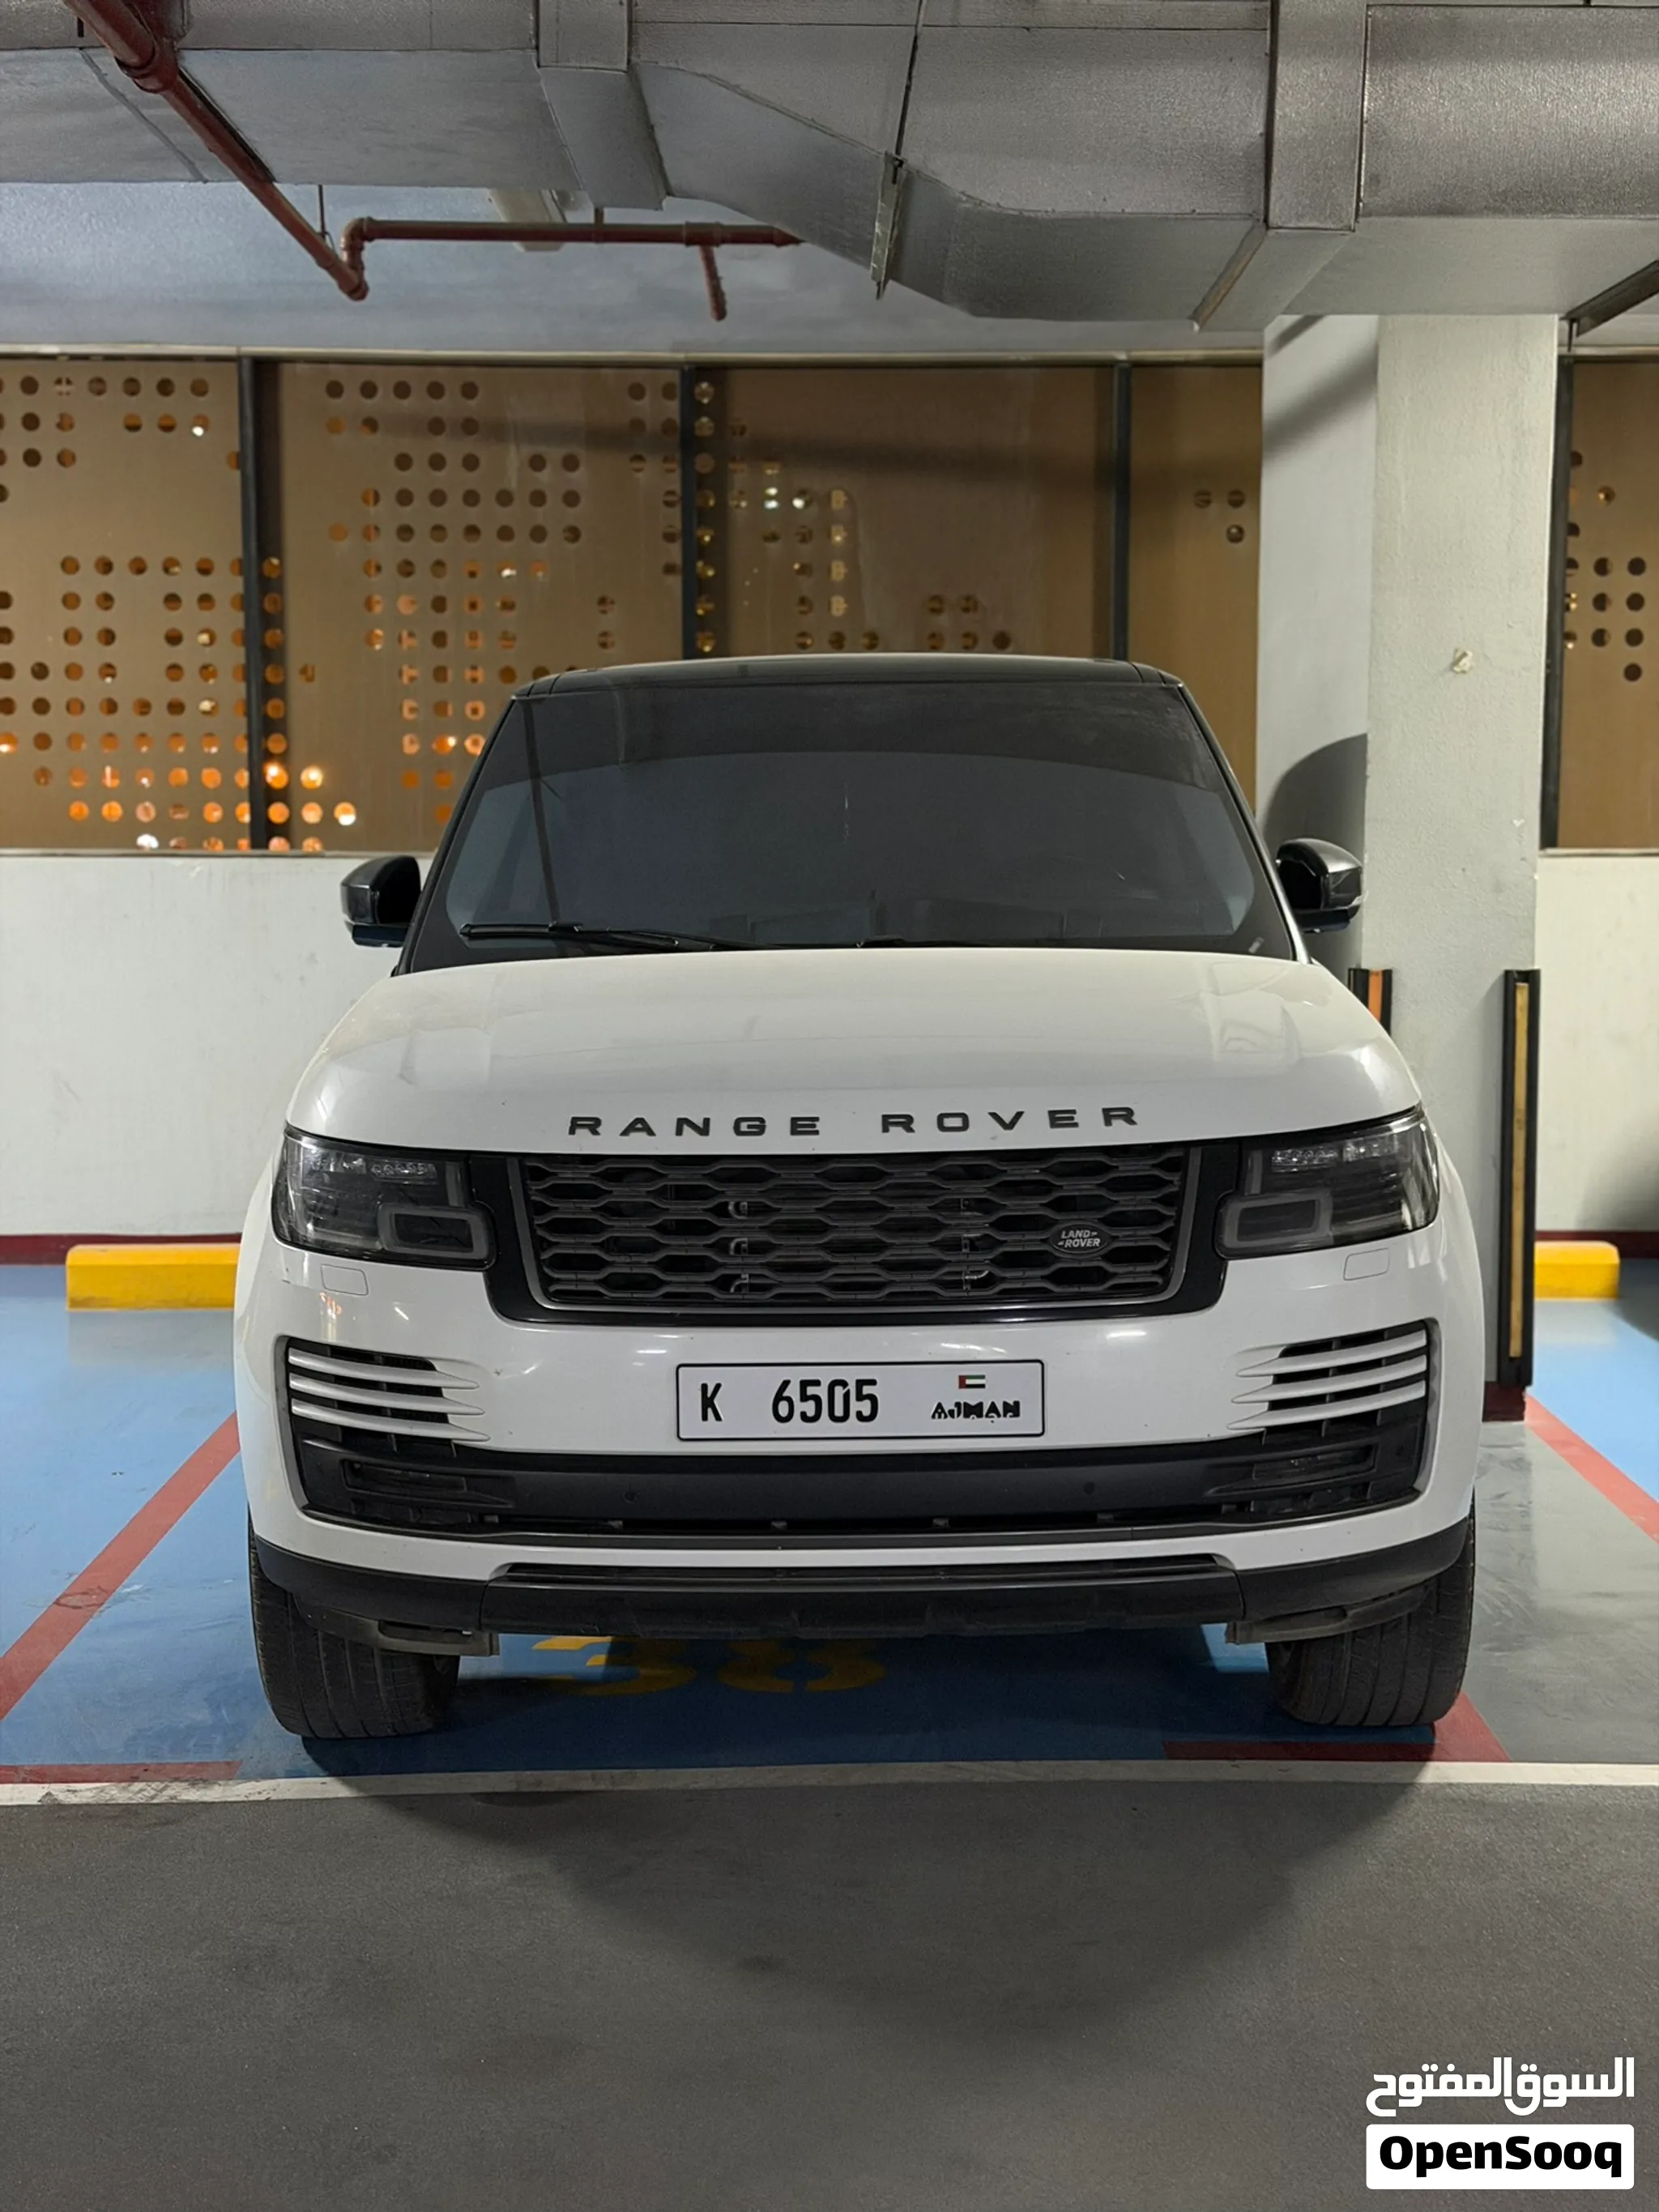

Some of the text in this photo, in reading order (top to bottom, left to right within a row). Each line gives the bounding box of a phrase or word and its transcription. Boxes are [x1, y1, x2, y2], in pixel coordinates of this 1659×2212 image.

[568, 1106, 1138, 1136] RANGE ROVER
[1060, 1230, 1091, 1239] LAND
[1064, 1238, 1101, 1248] ROVER
[700, 1379, 879, 1423] K 6505
[931, 1400, 1021, 1423] AJMAN
